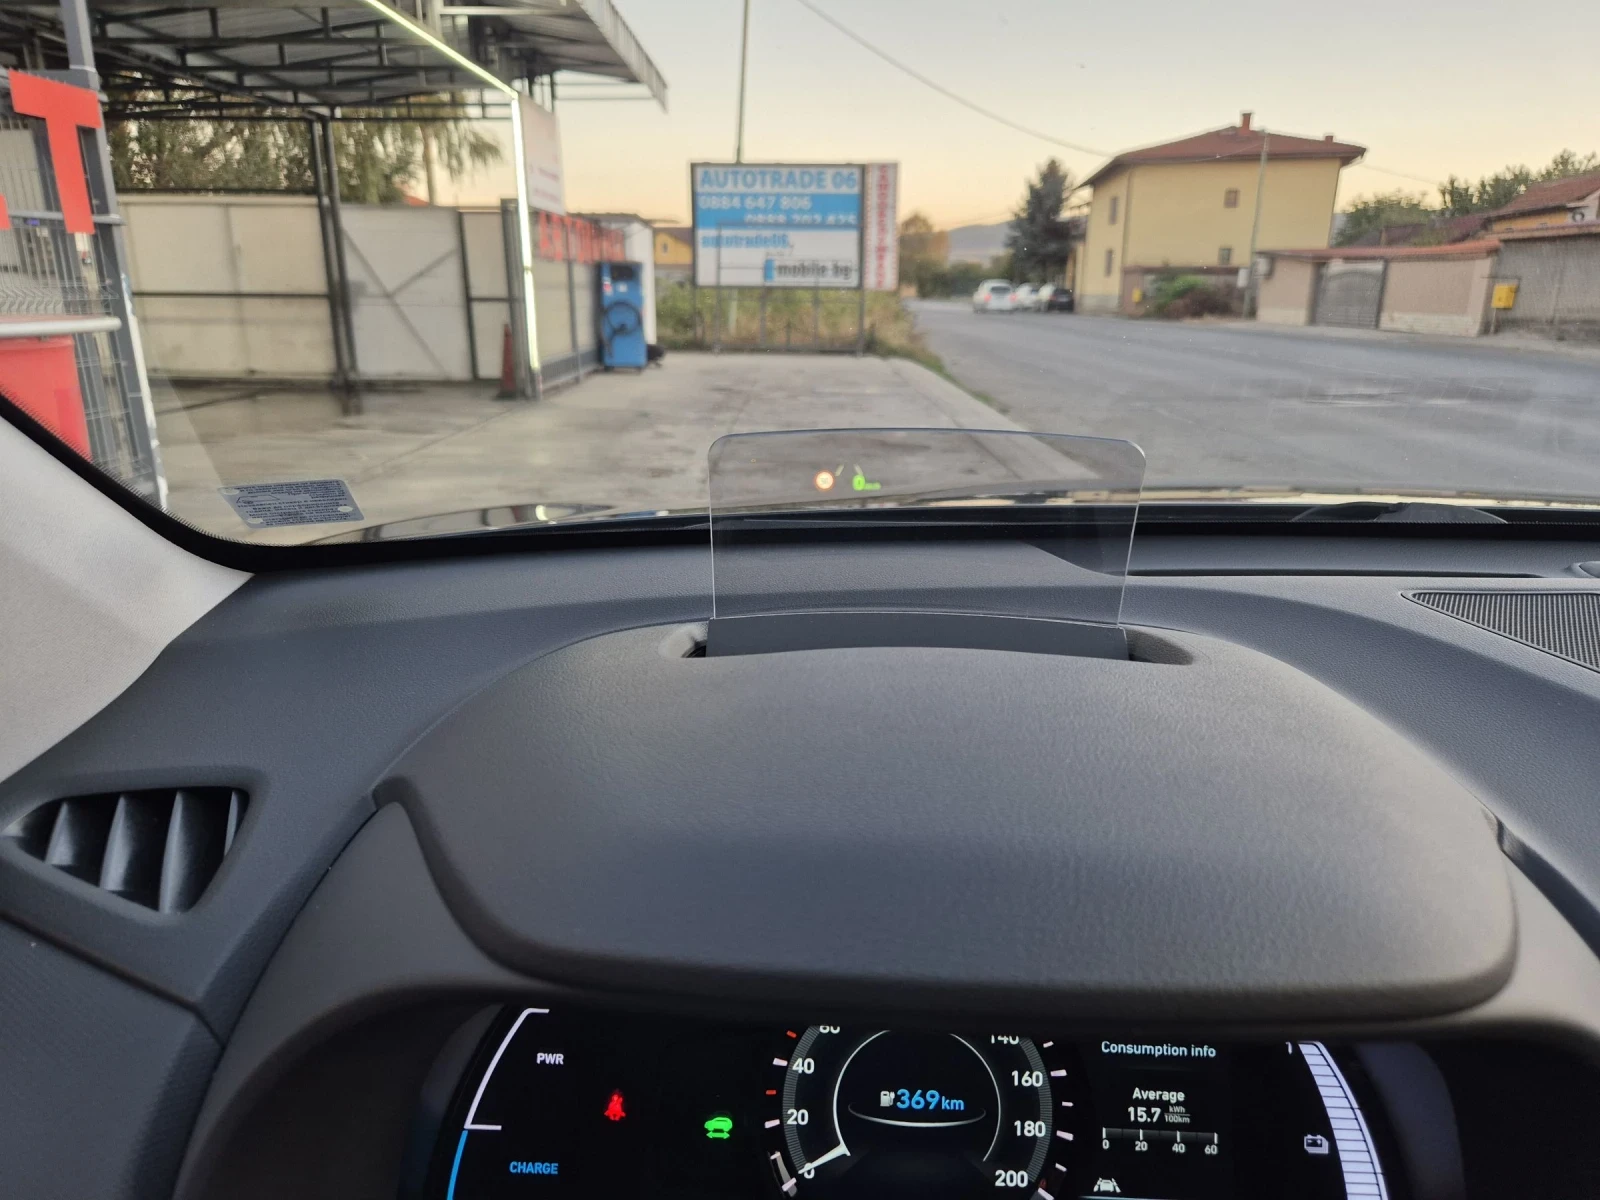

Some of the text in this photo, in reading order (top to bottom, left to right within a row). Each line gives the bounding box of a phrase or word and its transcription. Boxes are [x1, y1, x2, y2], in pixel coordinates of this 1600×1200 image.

[0, 68, 102, 234] T
[701, 170, 857, 189] AUTOTRADE 06
[1101, 1041, 1216, 1058] Consumption info
[536, 1053, 564, 1065] PWR
[792, 1058, 815, 1074] 40
[1011, 1070, 1043, 1087] 160
[896, 1089, 965, 1111] 369 km
[1132, 1087, 1185, 1103] Average
[787, 1109, 809, 1125] 20
[1127, 1106, 1161, 1123] 15.7
[1169, 1105, 1185, 1114] kWh
[1165, 1114, 1190, 1124] 100km
[1013, 1121, 1046, 1138] 180
[1102, 1139, 1218, 1155] 0 20 40 60
[509, 1162, 559, 1175] CHARGE
[995, 1170, 1028, 1188] 200
